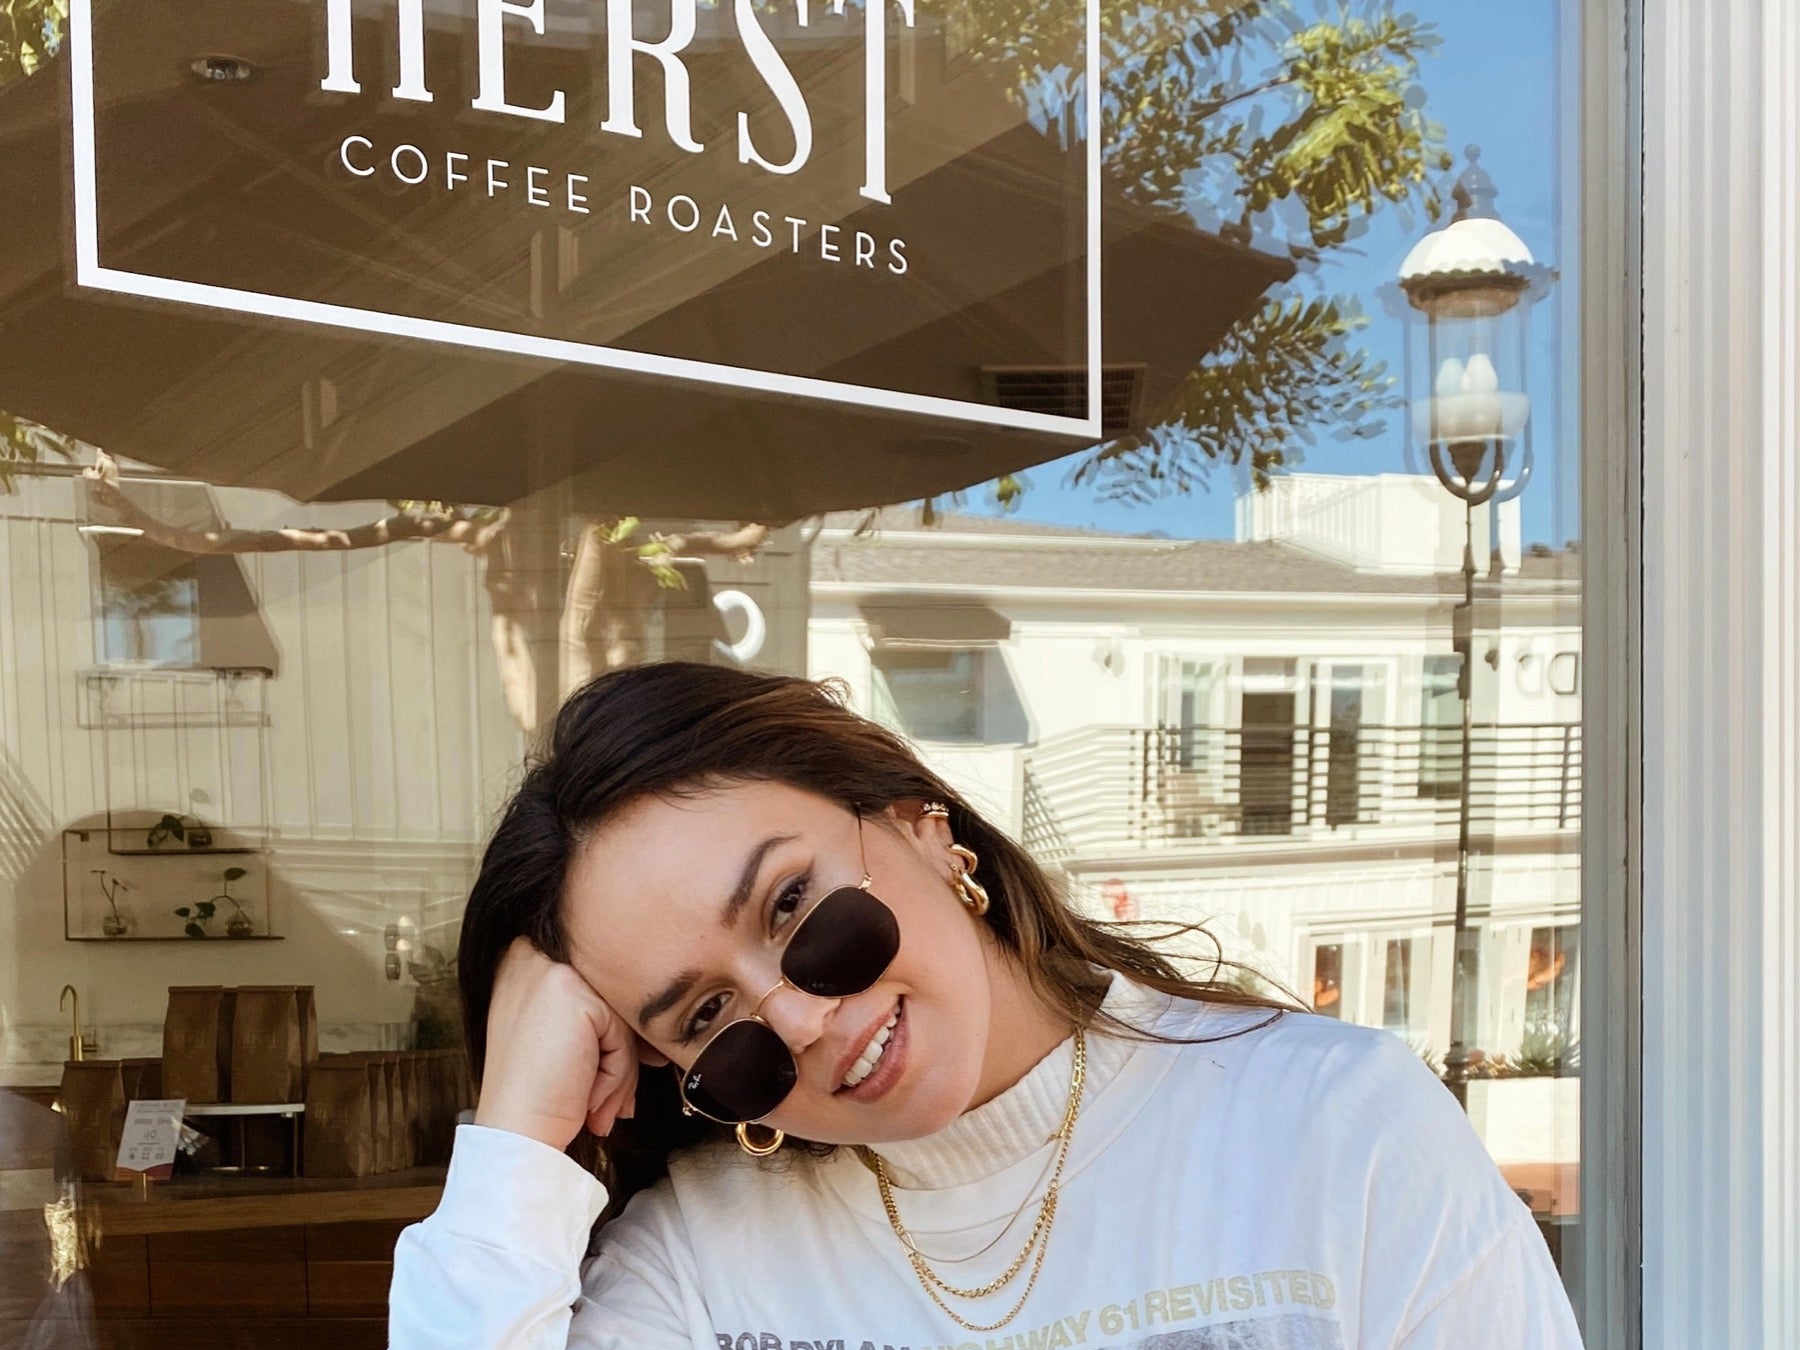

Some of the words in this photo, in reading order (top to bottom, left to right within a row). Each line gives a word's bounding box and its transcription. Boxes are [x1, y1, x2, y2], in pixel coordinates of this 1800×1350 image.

[340, 135, 590, 214] COFFEE
[629, 185, 908, 275] ROASTERS
[1099, 1298, 1140, 1336] 61
[1144, 1269, 1337, 1328] REVISITED
